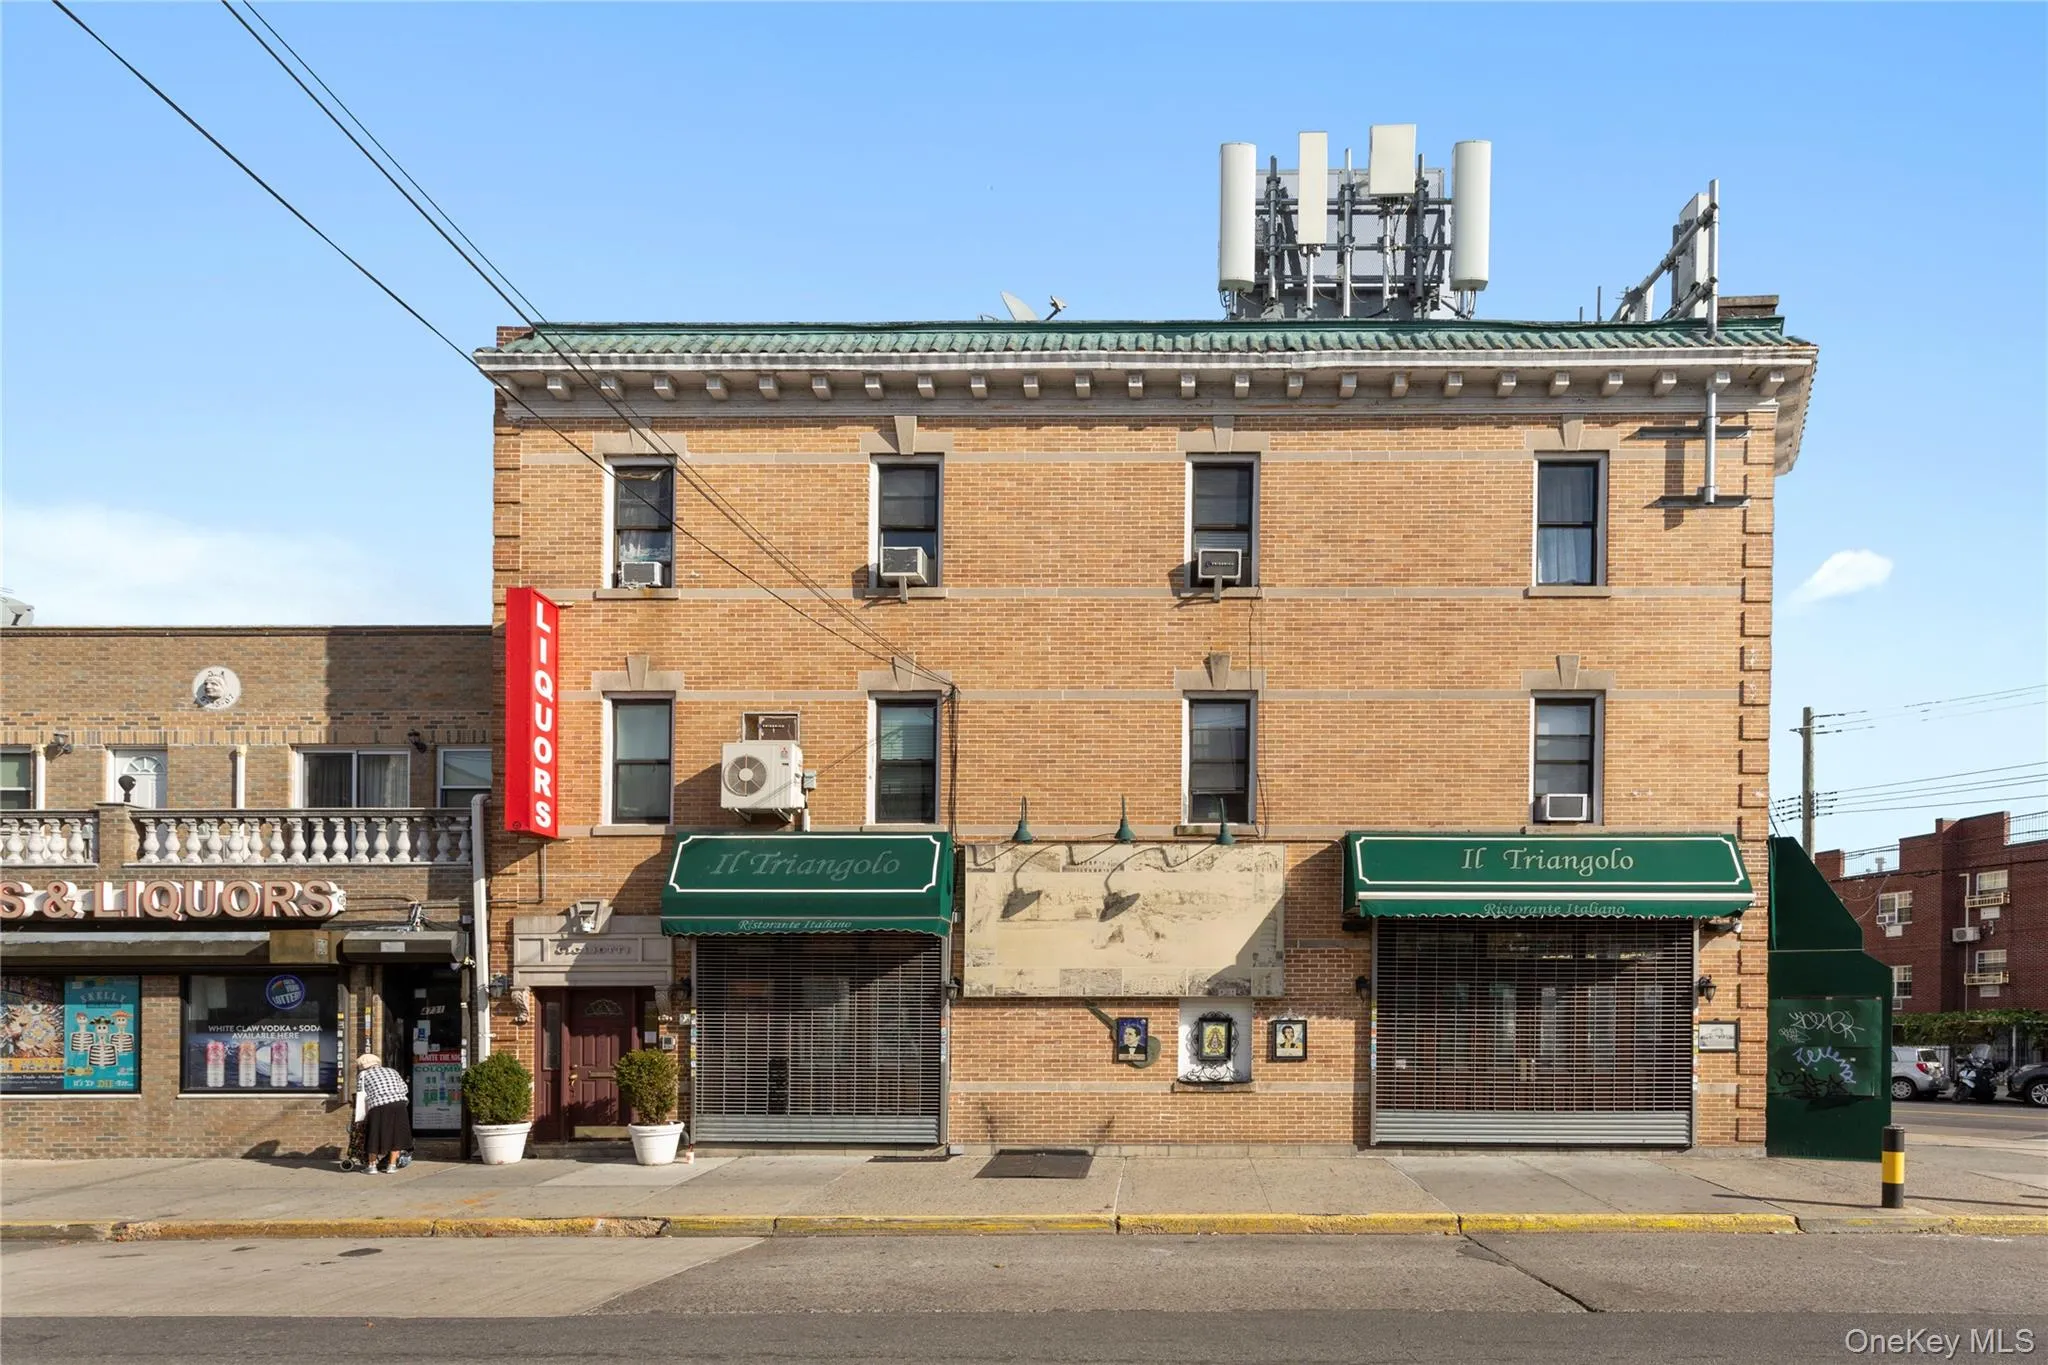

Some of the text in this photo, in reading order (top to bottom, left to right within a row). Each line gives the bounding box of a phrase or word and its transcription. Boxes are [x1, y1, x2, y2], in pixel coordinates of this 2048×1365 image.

[533, 600, 554, 829] LIQUORS
[710, 850, 900, 882] Il Triangolo
[1461, 847, 1634, 877] Il Triangolo
[43, 880, 84, 919] &
[94, 880, 334, 921] LIQUORS
[1483, 902, 1625, 916] Ristorante Italiano
[738, 919, 852, 930] Ristorante Italiano
